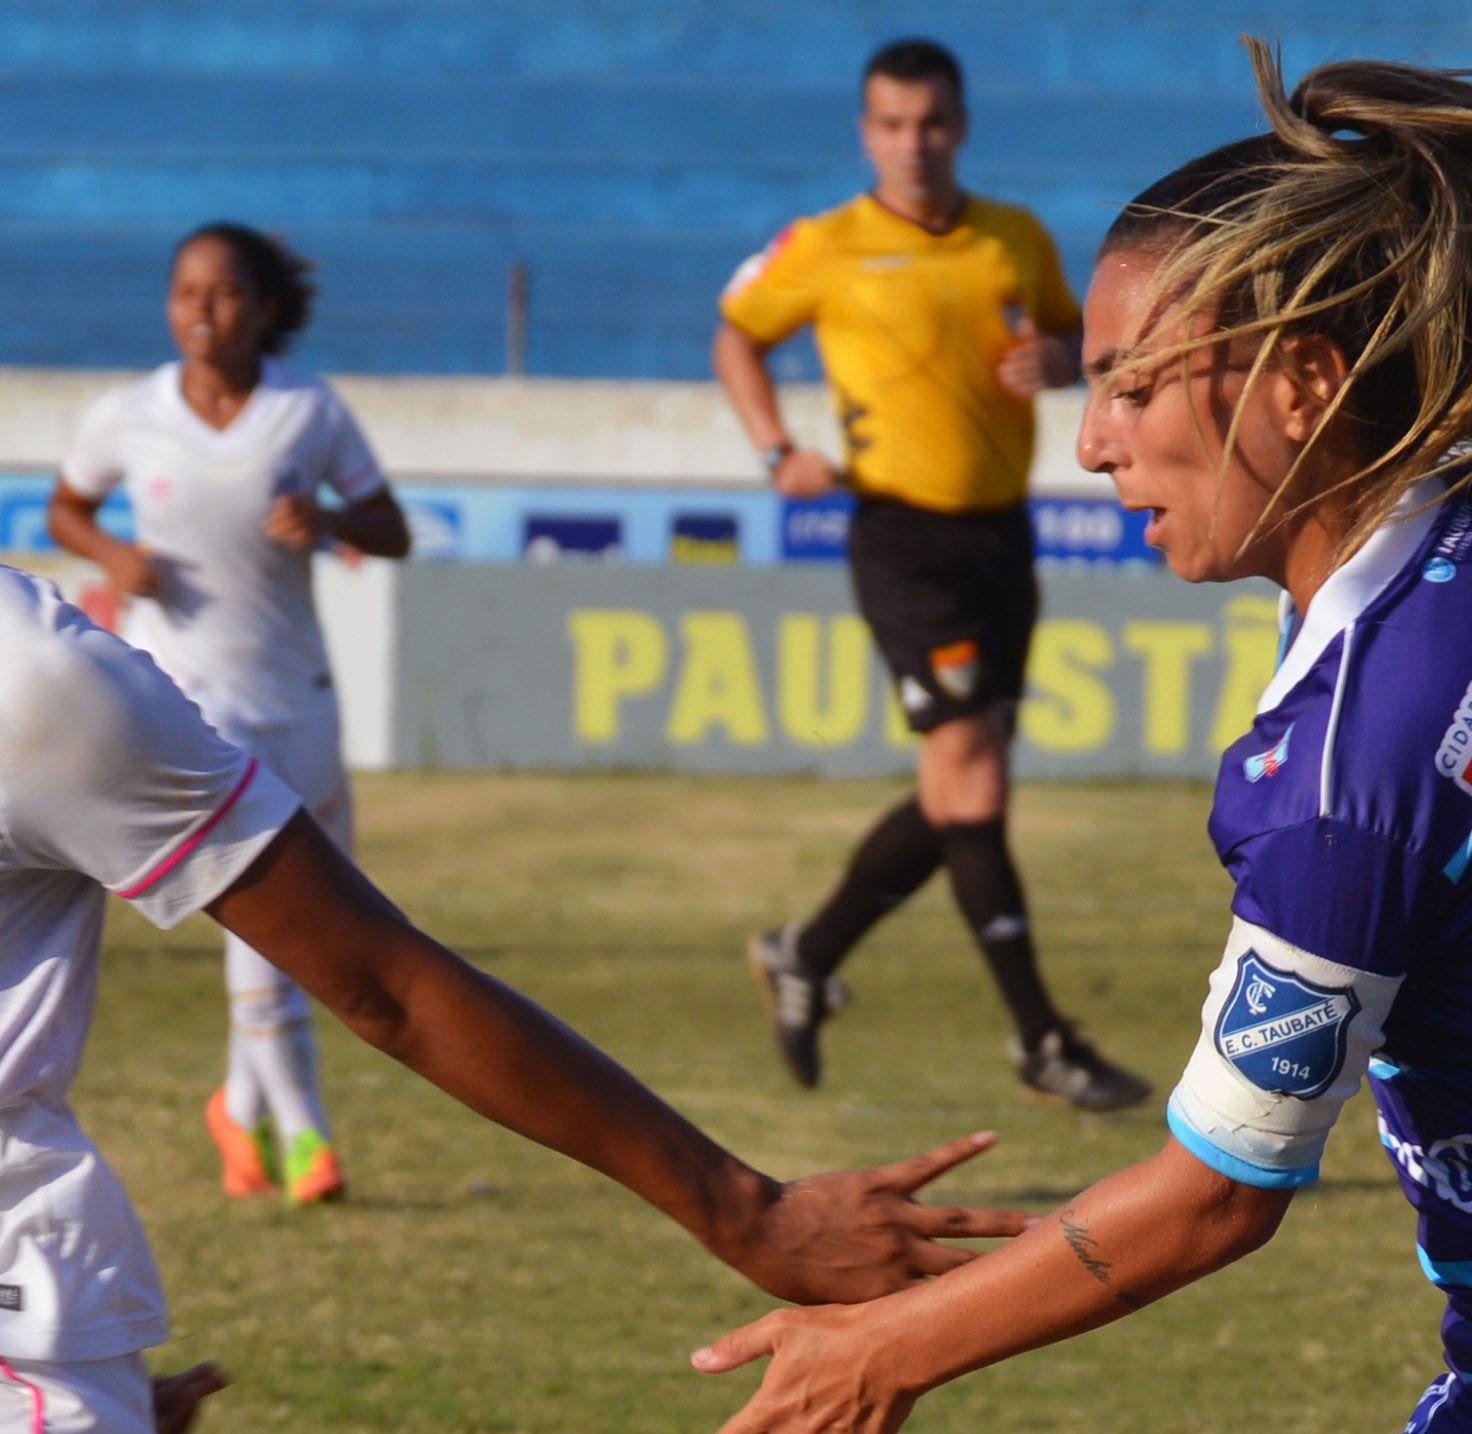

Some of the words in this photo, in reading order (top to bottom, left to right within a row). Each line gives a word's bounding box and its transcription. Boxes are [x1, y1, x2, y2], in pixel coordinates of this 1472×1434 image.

[568, 596, 1280, 757] PAUSTÃ
[1225, 1039, 1240, 1055] E.
[1241, 1033, 1259, 1049] C.
[1271, 1056, 1311, 1080] 1914
